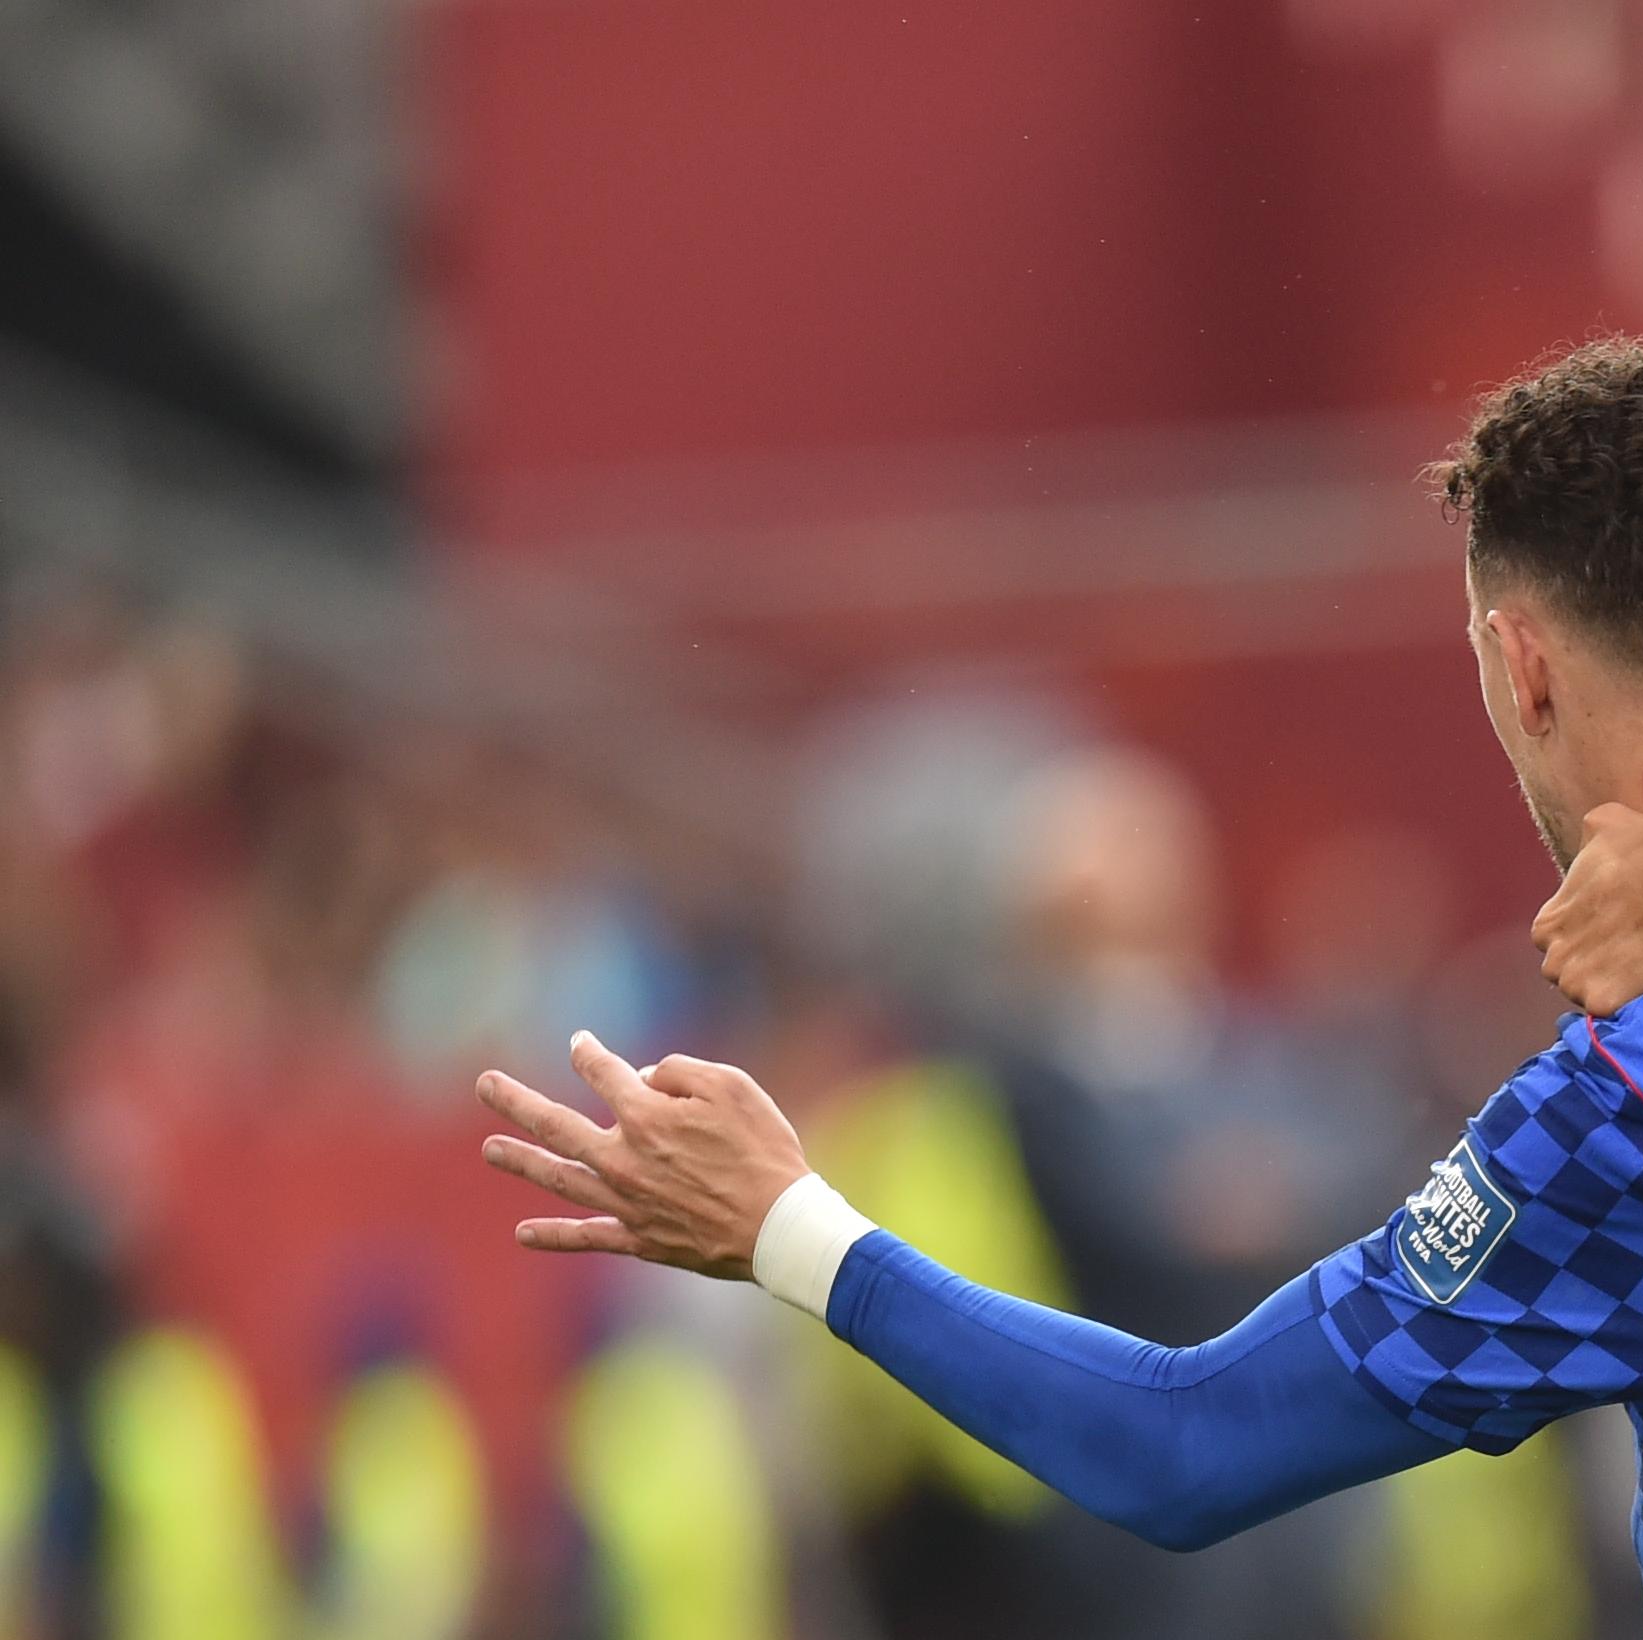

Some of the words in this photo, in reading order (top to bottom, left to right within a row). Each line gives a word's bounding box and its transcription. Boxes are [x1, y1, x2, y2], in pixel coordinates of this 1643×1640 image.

[1440, 1161, 1492, 1228] OOTBALL
[1408, 1230, 1432, 1264] FIFA
[1421, 1217, 1471, 1273] World
